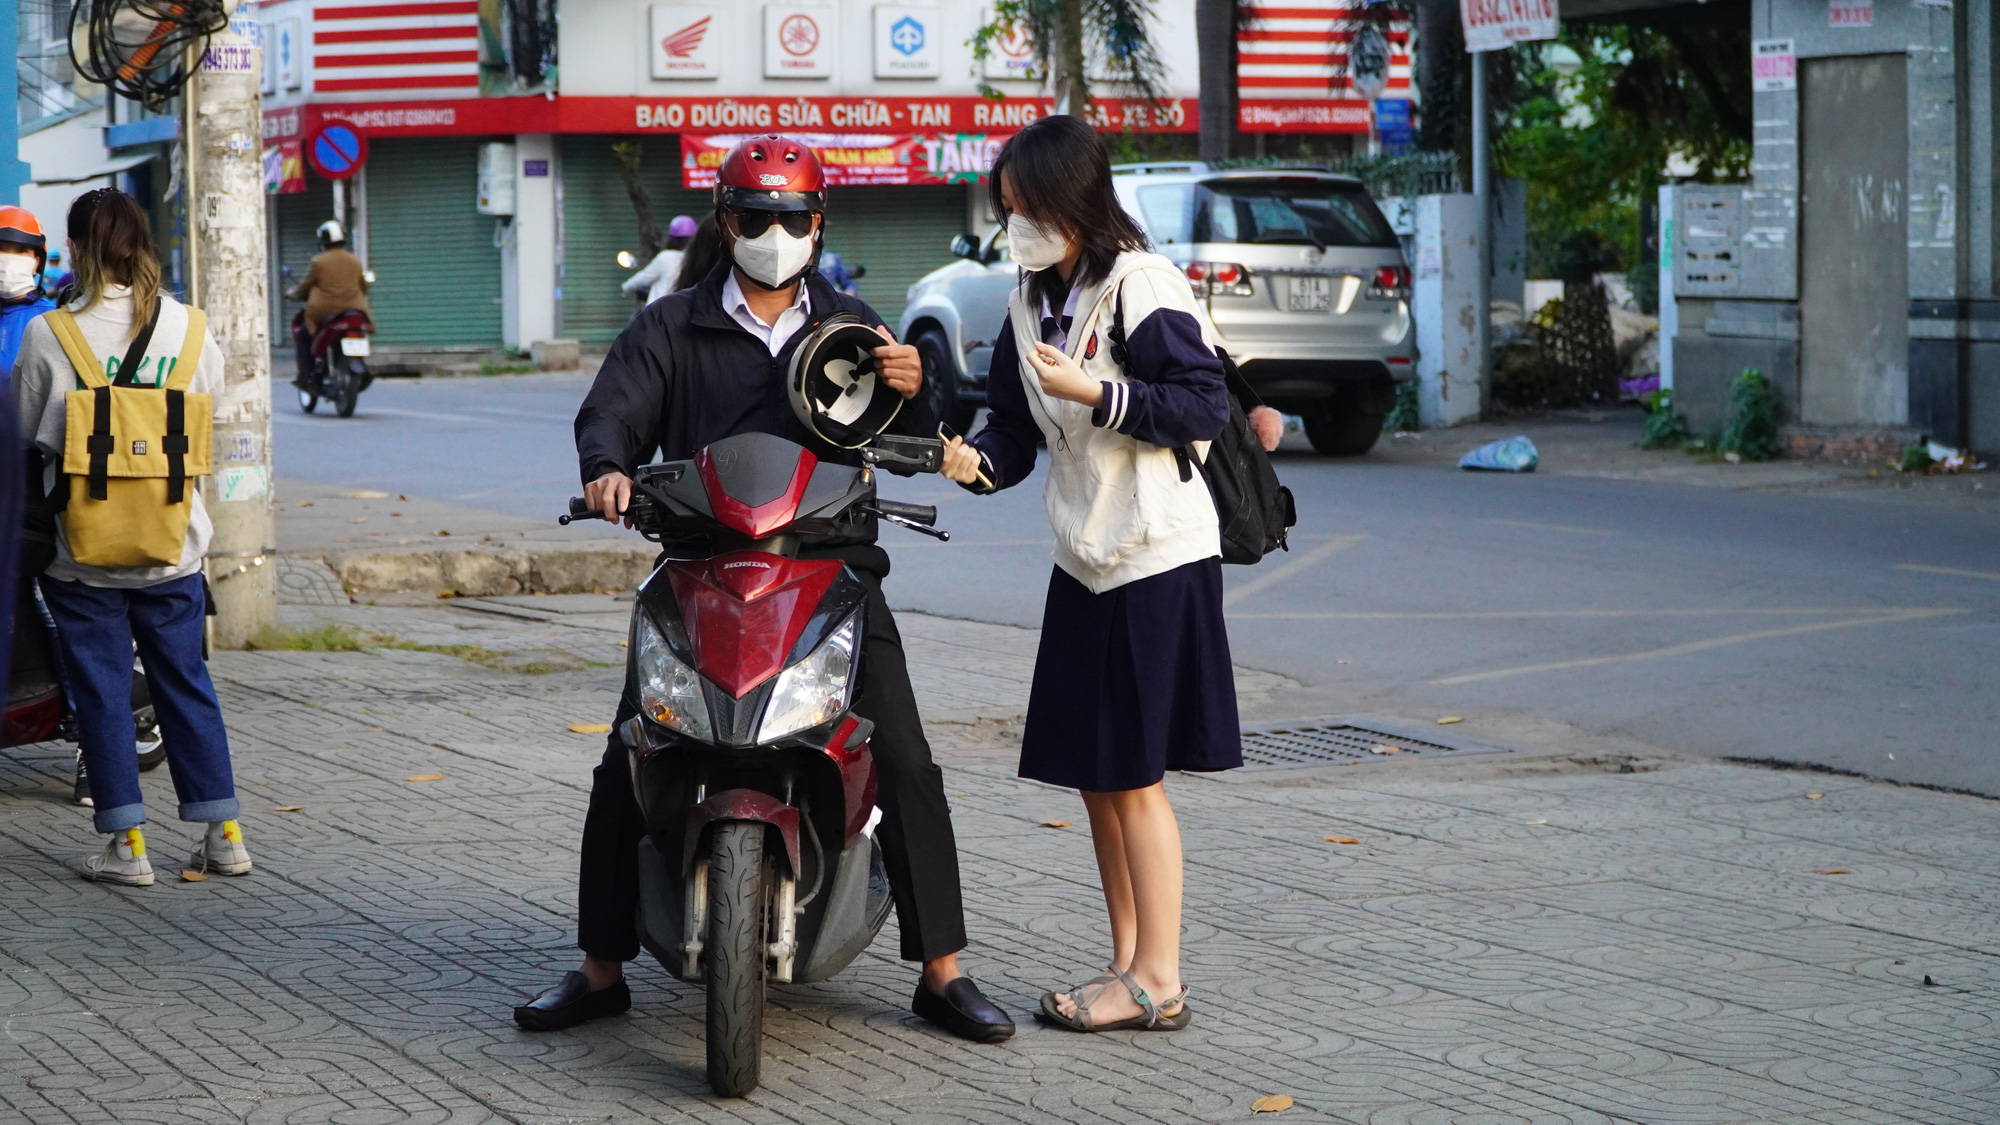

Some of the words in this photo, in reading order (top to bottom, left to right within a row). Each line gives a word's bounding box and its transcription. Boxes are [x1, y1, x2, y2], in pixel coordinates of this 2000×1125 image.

[690, 98, 772, 127] DƯỠNG
[777, 97, 823, 127] SỬA
[830, 99, 892, 127] CHỮA
[723, 561, 771, 570] HONDA
